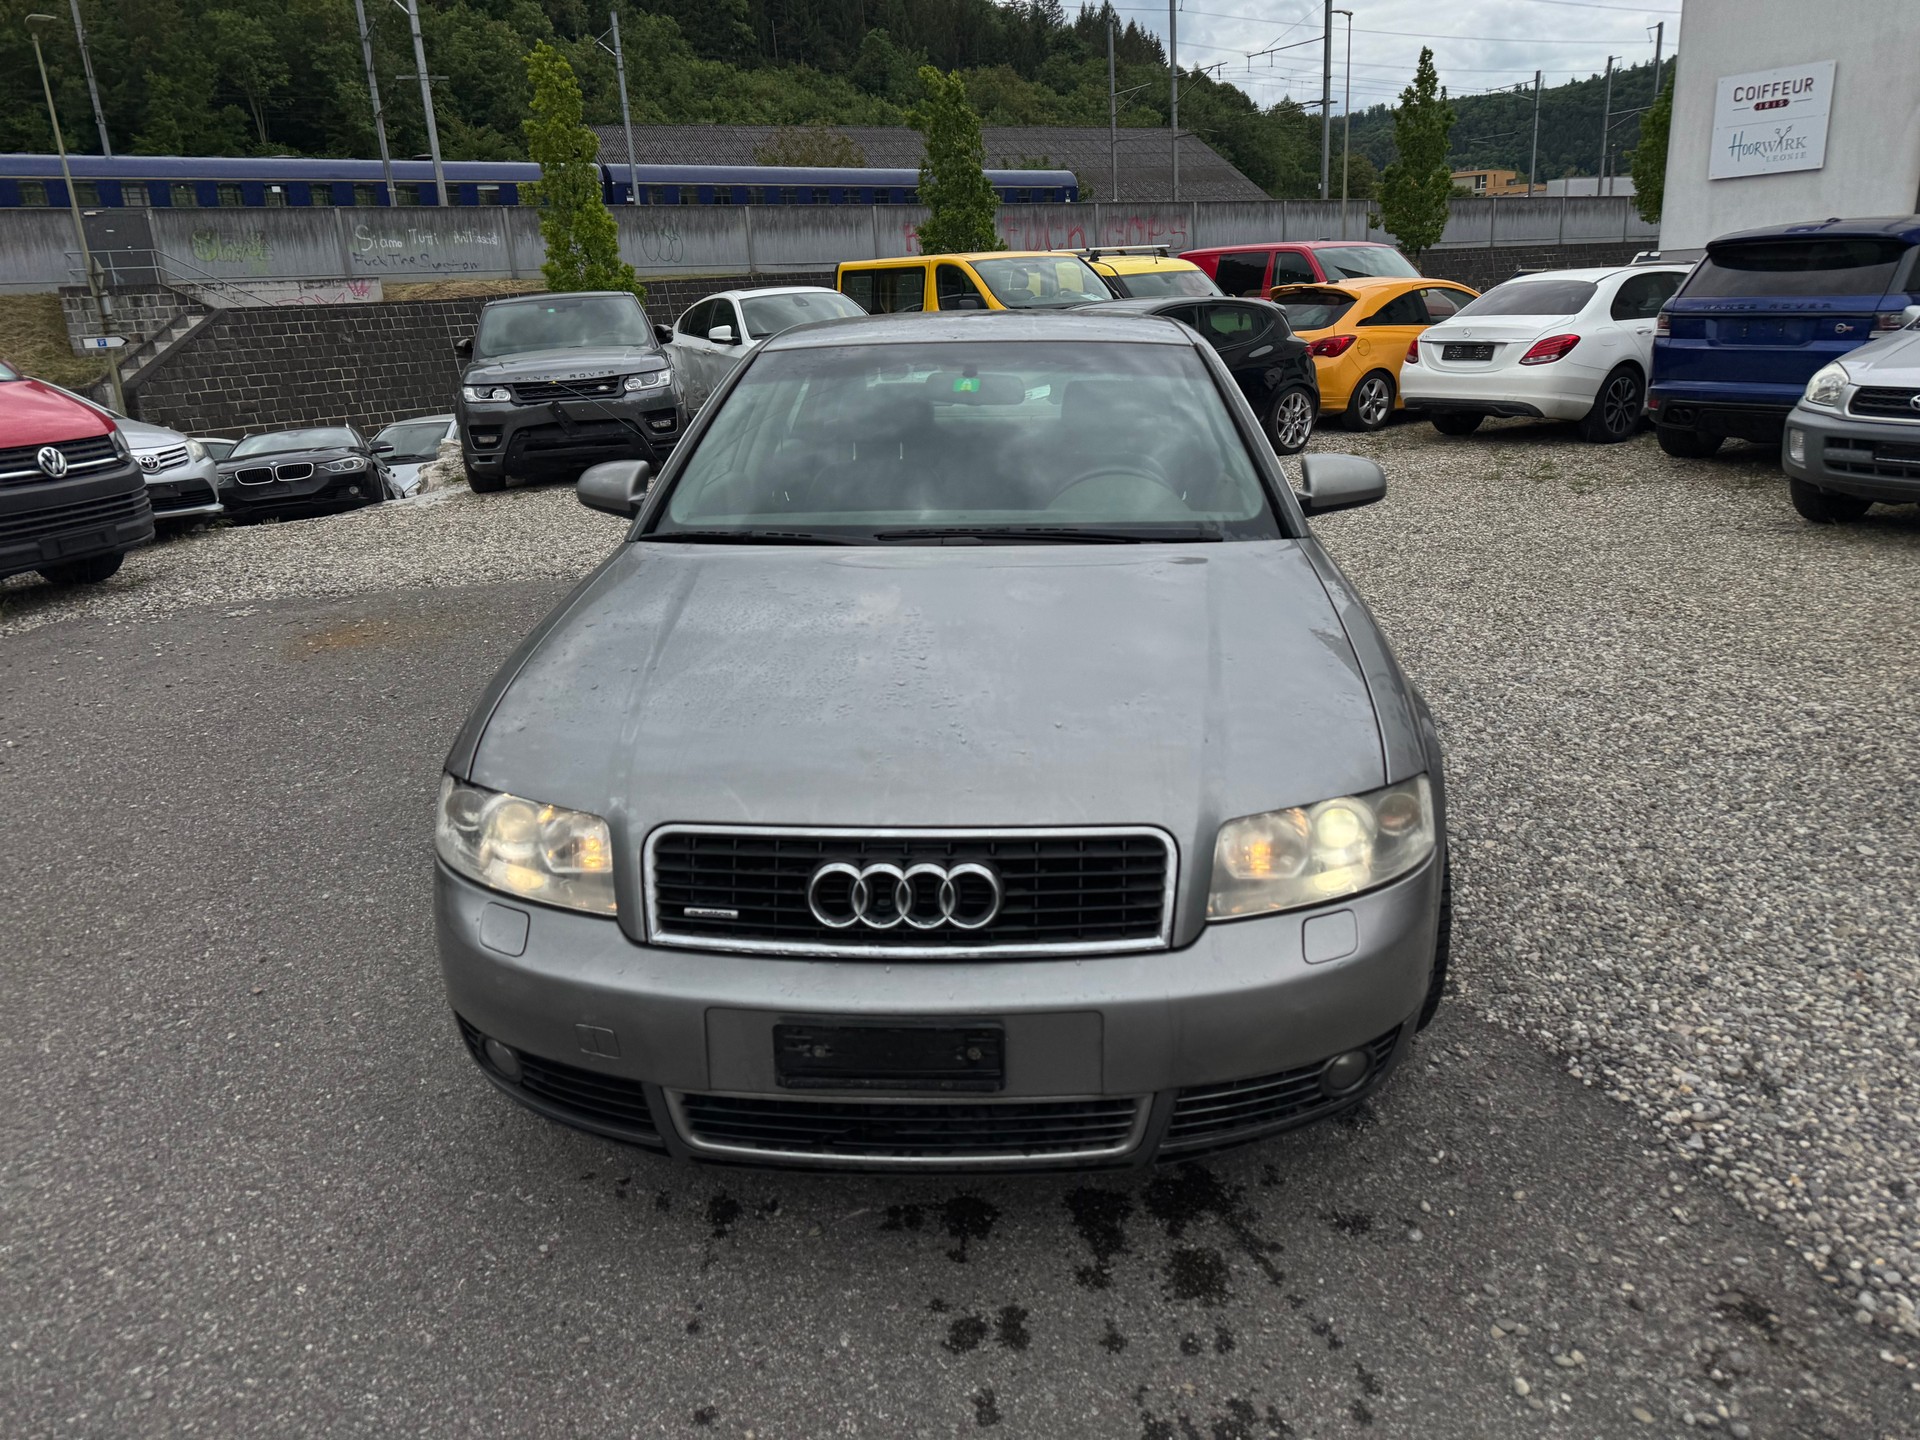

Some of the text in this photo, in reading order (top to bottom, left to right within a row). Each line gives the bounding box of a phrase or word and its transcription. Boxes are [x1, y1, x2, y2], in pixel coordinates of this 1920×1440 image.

[1733, 77, 1814, 102] COIFFEUR
[1759, 99, 1785, 110] IRIS
[1765, 152, 1807, 163] LEONIE
[355, 224, 402, 251] Siamo
[569, 370, 615, 379] ROVER
